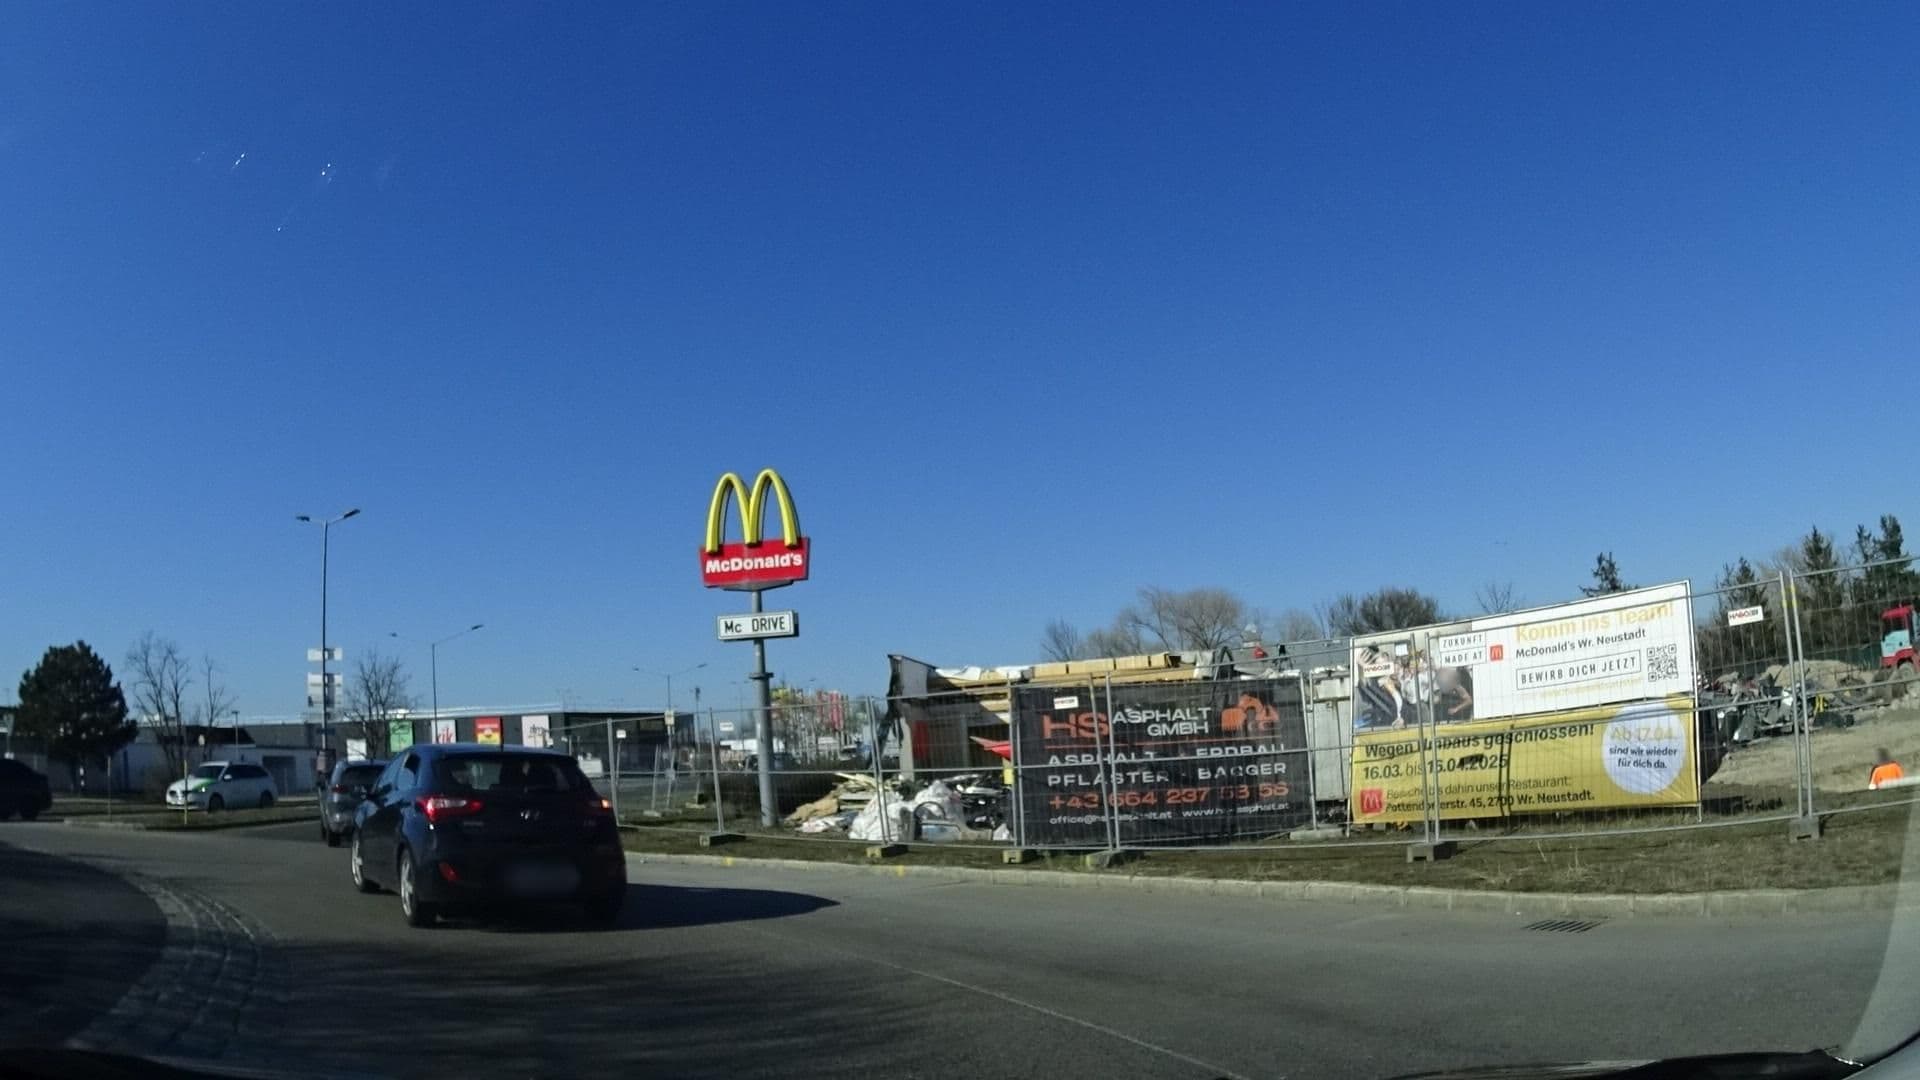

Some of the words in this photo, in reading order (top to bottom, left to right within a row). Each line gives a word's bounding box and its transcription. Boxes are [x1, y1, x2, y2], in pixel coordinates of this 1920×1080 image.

[705, 552, 803, 574] McDonald's
[724, 620, 743, 634] Mc
[752, 616, 786, 632] DRIVE
[1516, 623, 1577, 644] Komm
[1581, 613, 1611, 632] ins
[1618, 602, 1674, 626] Team!
[1442, 634, 1484, 648] ZUKUNFT
[1515, 641, 1575, 659] McDonald's
[1577, 637, 1594, 650] Wr.
[1596, 628, 1648, 646] Neustadt
[1444, 652, 1471, 664] MADE
[1472, 651, 1484, 662] AT
[1520, 668, 1564, 684] BEWIRB
[1568, 664, 1597, 678] DICH
[1601, 656, 1637, 673] JETZT
[1041, 711, 1109, 739] HS
[1112, 706, 1212, 726] ASPHALT
[1147, 723, 1209, 738] GMBH
[1365, 741, 1414, 760] Wegen
[1609, 746, 1629, 756] sind
[1630, 746, 1644, 757] wir
[1645, 746, 1678, 757] wieder
[1363, 764, 1403, 780] 16.03.
[1617, 758, 1631, 768] für
[1632, 758, 1652, 769] dich
[1653, 759, 1668, 769] da.
[1048, 770, 1170, 787] PFLASTER
[1197, 762, 1288, 781] BAGGER
[1049, 791, 1100, 810] +43
[1108, 790, 1157, 807] 664
[1166, 786, 1211, 805] 237
[1444, 782, 1475, 796] dahin
[1469, 797, 1486, 810] 45,
[1516, 793, 1536, 806] Wr.
[1536, 789, 1595, 805] Neustadt.
